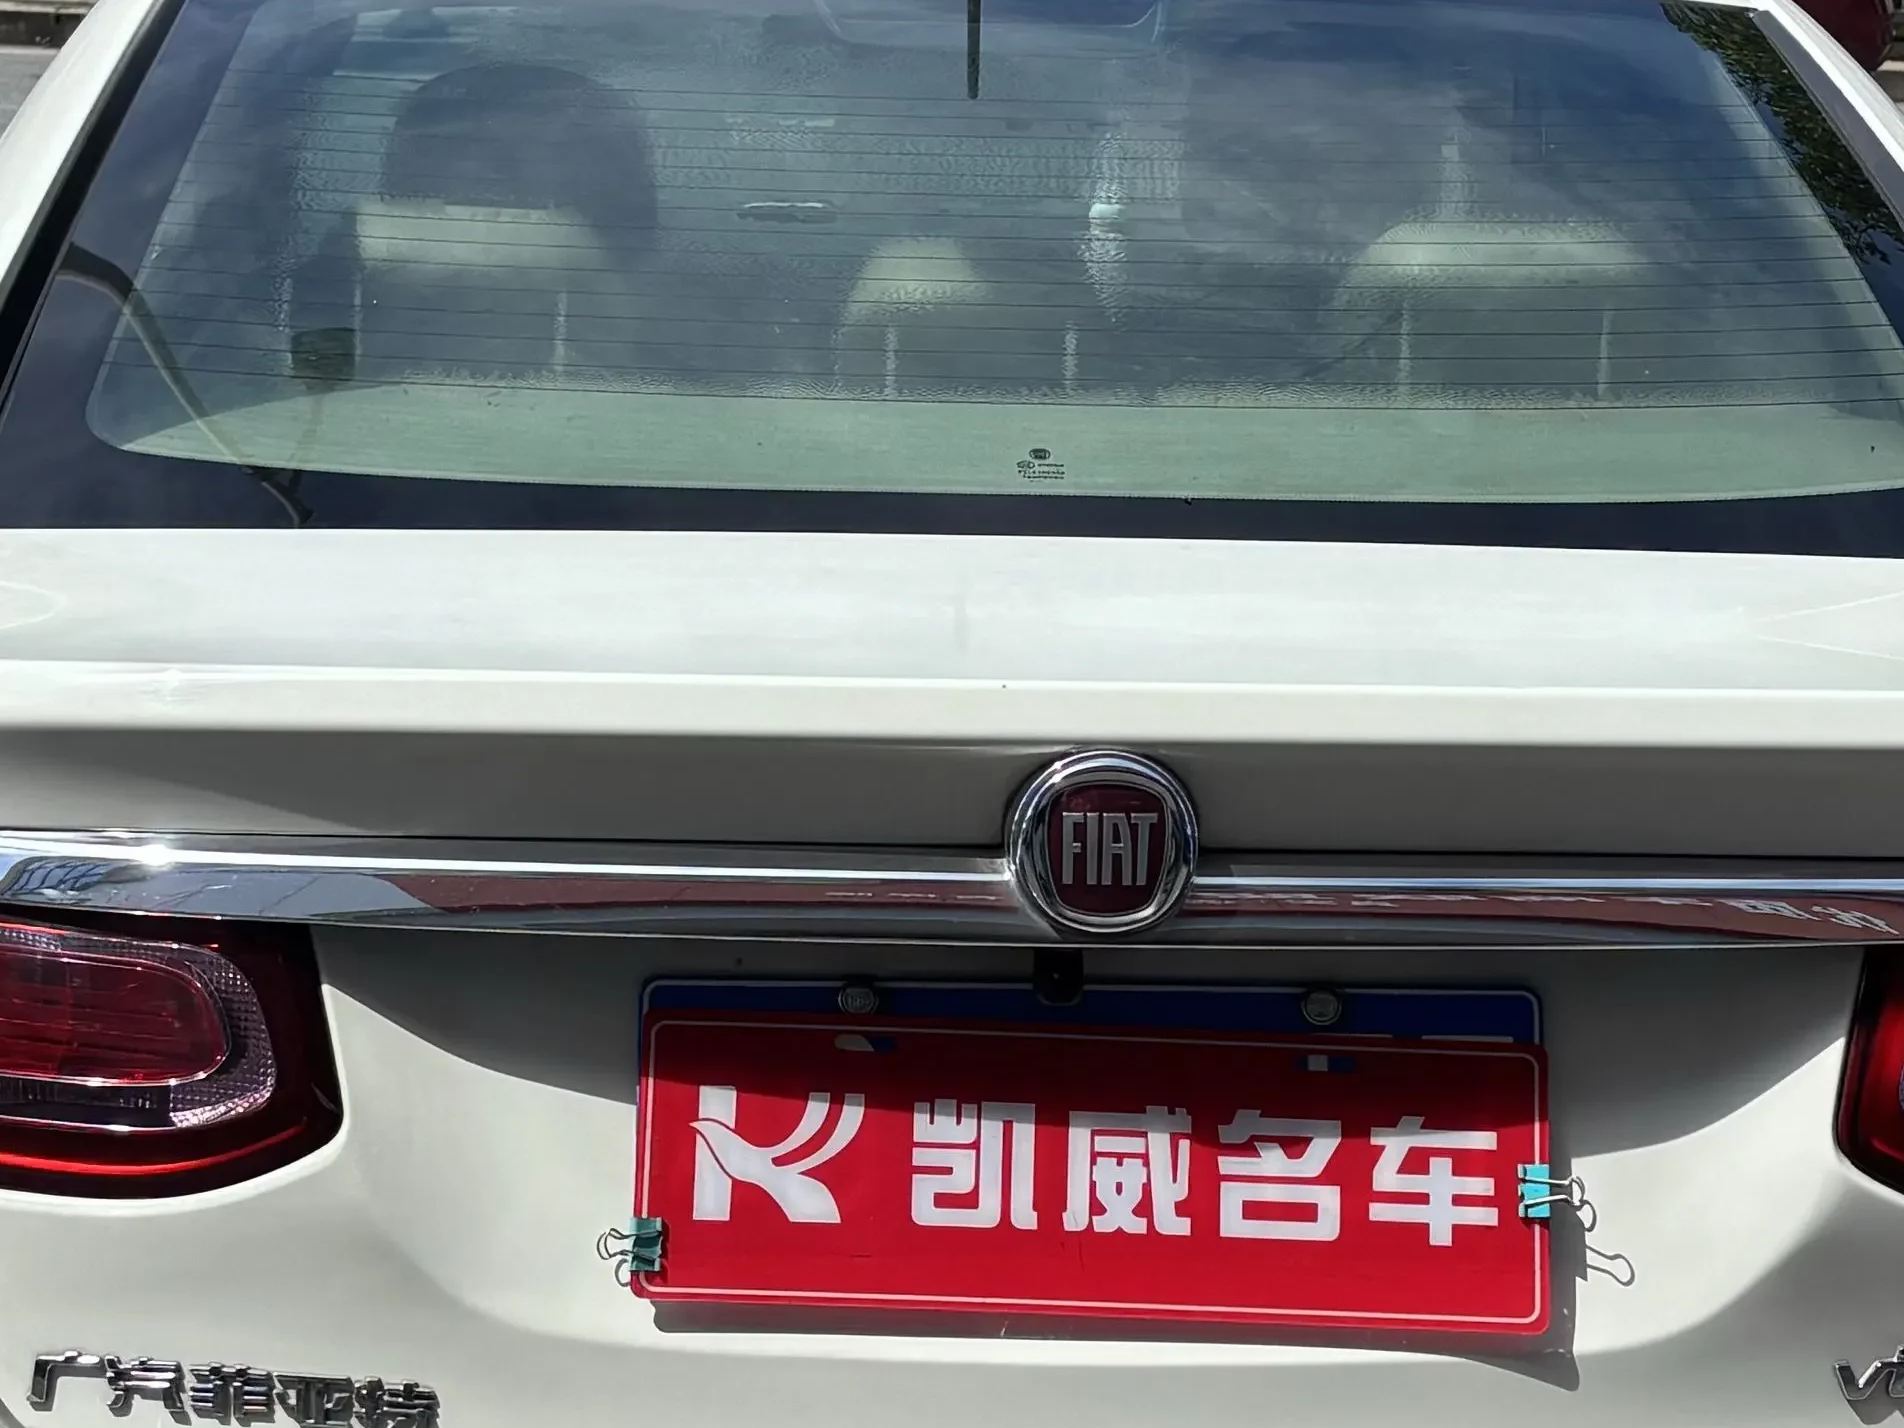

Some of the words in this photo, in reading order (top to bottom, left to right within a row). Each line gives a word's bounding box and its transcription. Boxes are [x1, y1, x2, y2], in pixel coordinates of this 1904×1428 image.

[1061, 811, 1159, 886] FIAT
[908, 1097, 1499, 1247] 凯威名车
